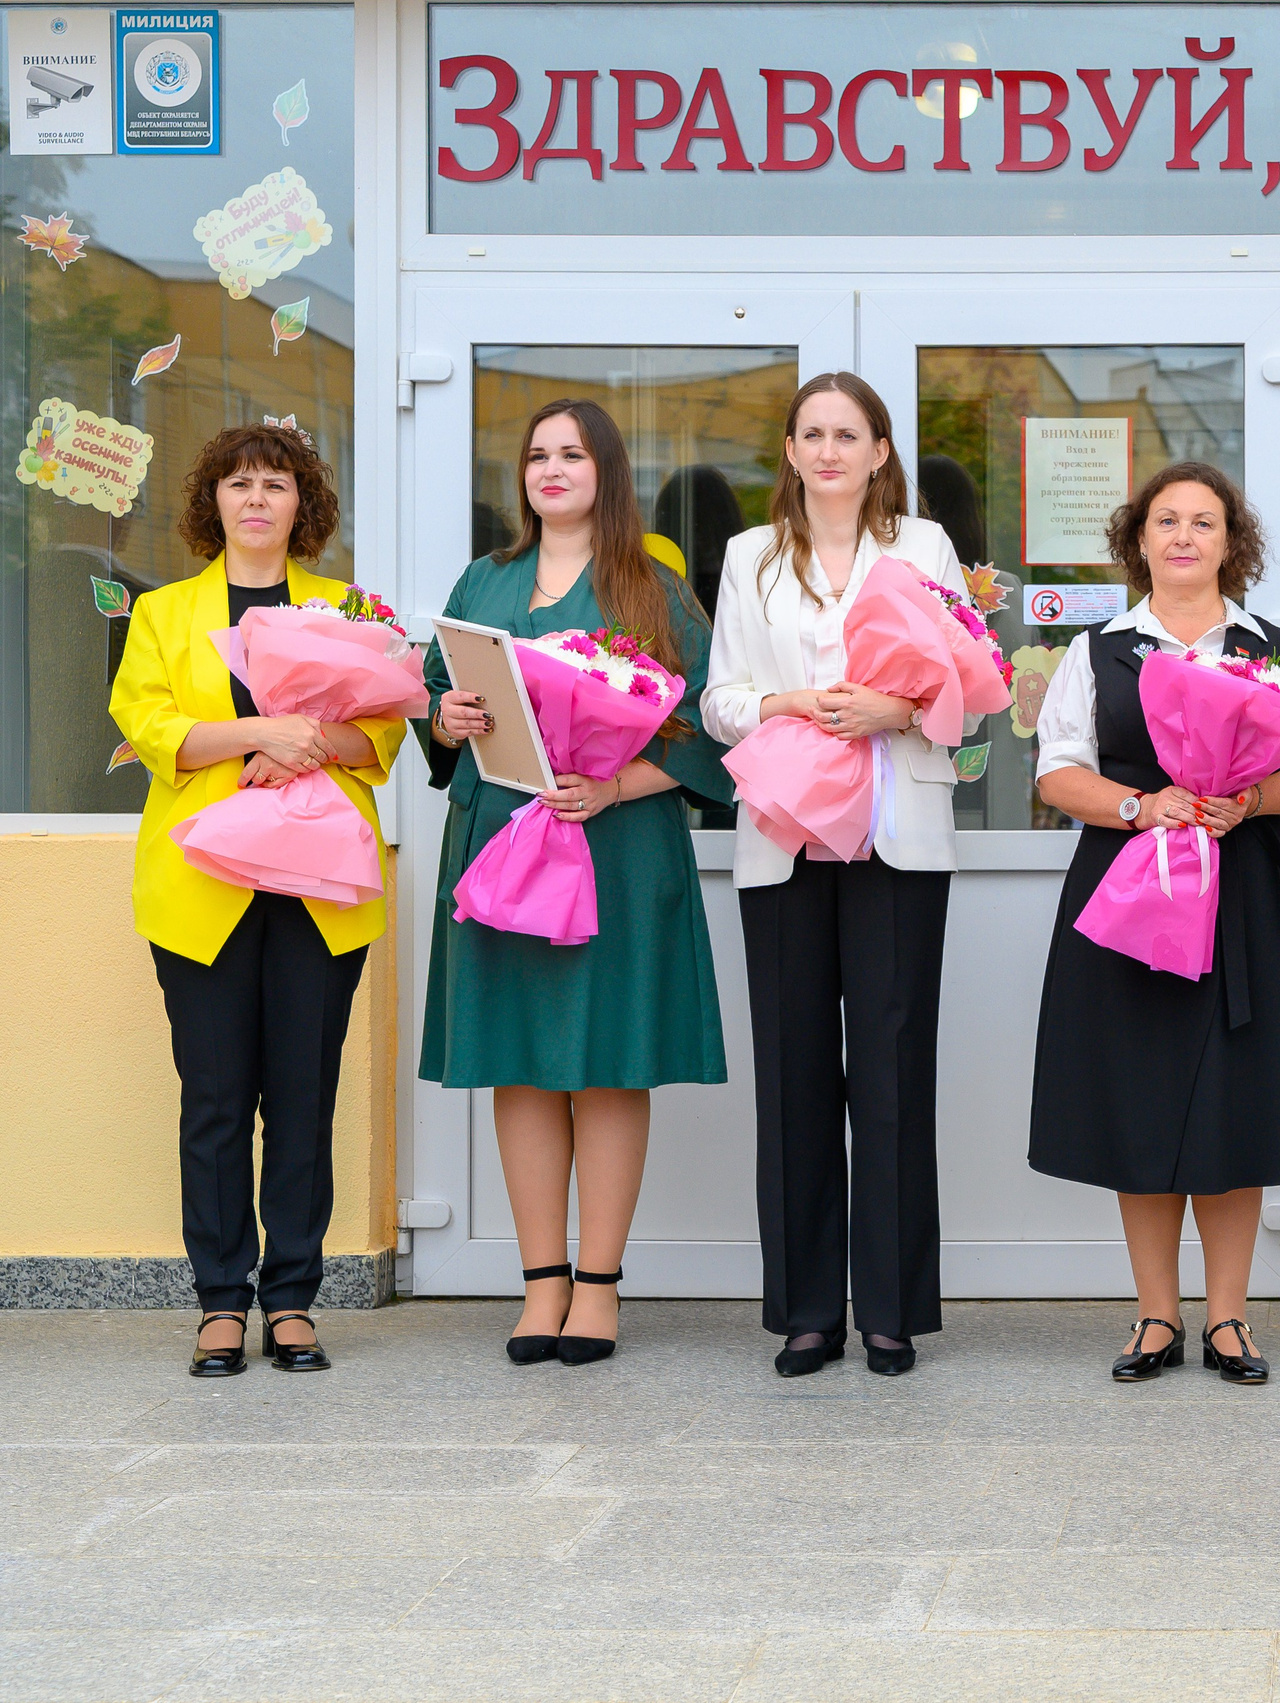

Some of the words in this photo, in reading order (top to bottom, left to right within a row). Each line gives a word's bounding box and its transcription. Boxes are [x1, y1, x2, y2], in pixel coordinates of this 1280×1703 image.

[122, 16, 214, 30] МИЛИЦИЯ
[23, 55, 97, 65] ВНИМАНИЕ
[130, 121, 182, 129] ДЕПАРТАМЕНТОМ
[227, 190, 269, 220] Буду
[74, 418, 106, 438] уже
[109, 432, 143, 455] жду
[1041, 429, 1120, 439] ВНИМАНИЕ!
[72, 437, 134, 468] осенние
[1066, 445, 1088, 454] Вход
[1053, 461, 1109, 470] учреждение
[1051, 473, 1110, 484] образования
[1041, 489, 1085, 498] разрешен
[1052, 502, 1100, 510] учащимся
